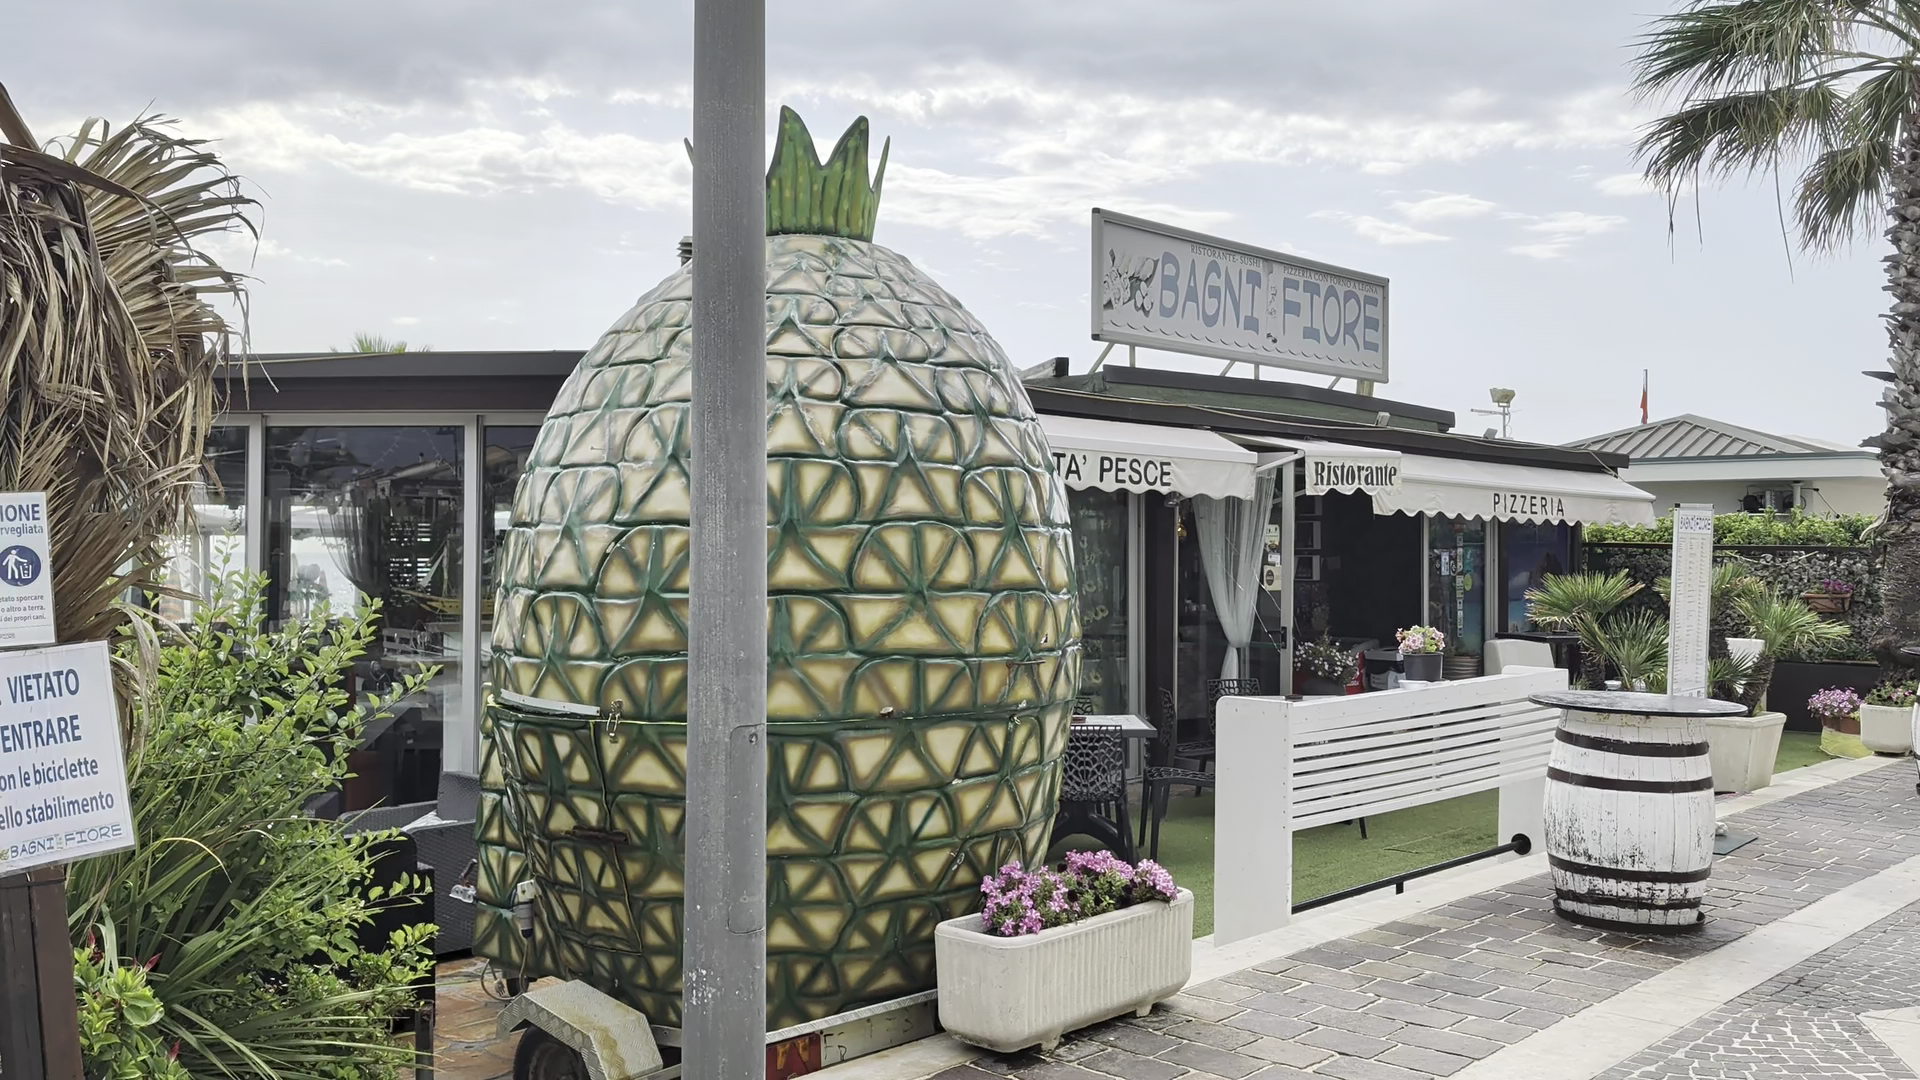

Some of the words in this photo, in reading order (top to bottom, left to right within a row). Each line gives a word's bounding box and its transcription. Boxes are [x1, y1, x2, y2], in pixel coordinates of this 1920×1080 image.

[1240, 255, 1261, 269] SUSHI
[1283, 265, 1313, 280] PIZZERIA
[1313, 272, 1329, 283] CON
[1329, 275, 1352, 289] FORNO
[1352, 282, 1358, 290] A
[1358, 284, 1379, 295] LEGNA
[1158, 251, 1262, 336] BAGNI
[1282, 277, 1380, 353] FIORE
[1100, 456, 1172, 487] PESCE
[1313, 461, 1398, 487] Ristorante
[1492, 492, 1565, 517] PIZZERIA
[16, 594, 44, 602] sporcare
[14, 614, 31, 622] propri
[7, 668, 80, 704] VIETATO
[0, 714, 82, 753] ENTRARE
[18, 765, 31, 788] le
[33, 757, 99, 786] biciclette
[25, 791, 115, 825] stabilimento
[10, 837, 55, 859] BAGNI
[64, 824, 123, 846] FIORE
